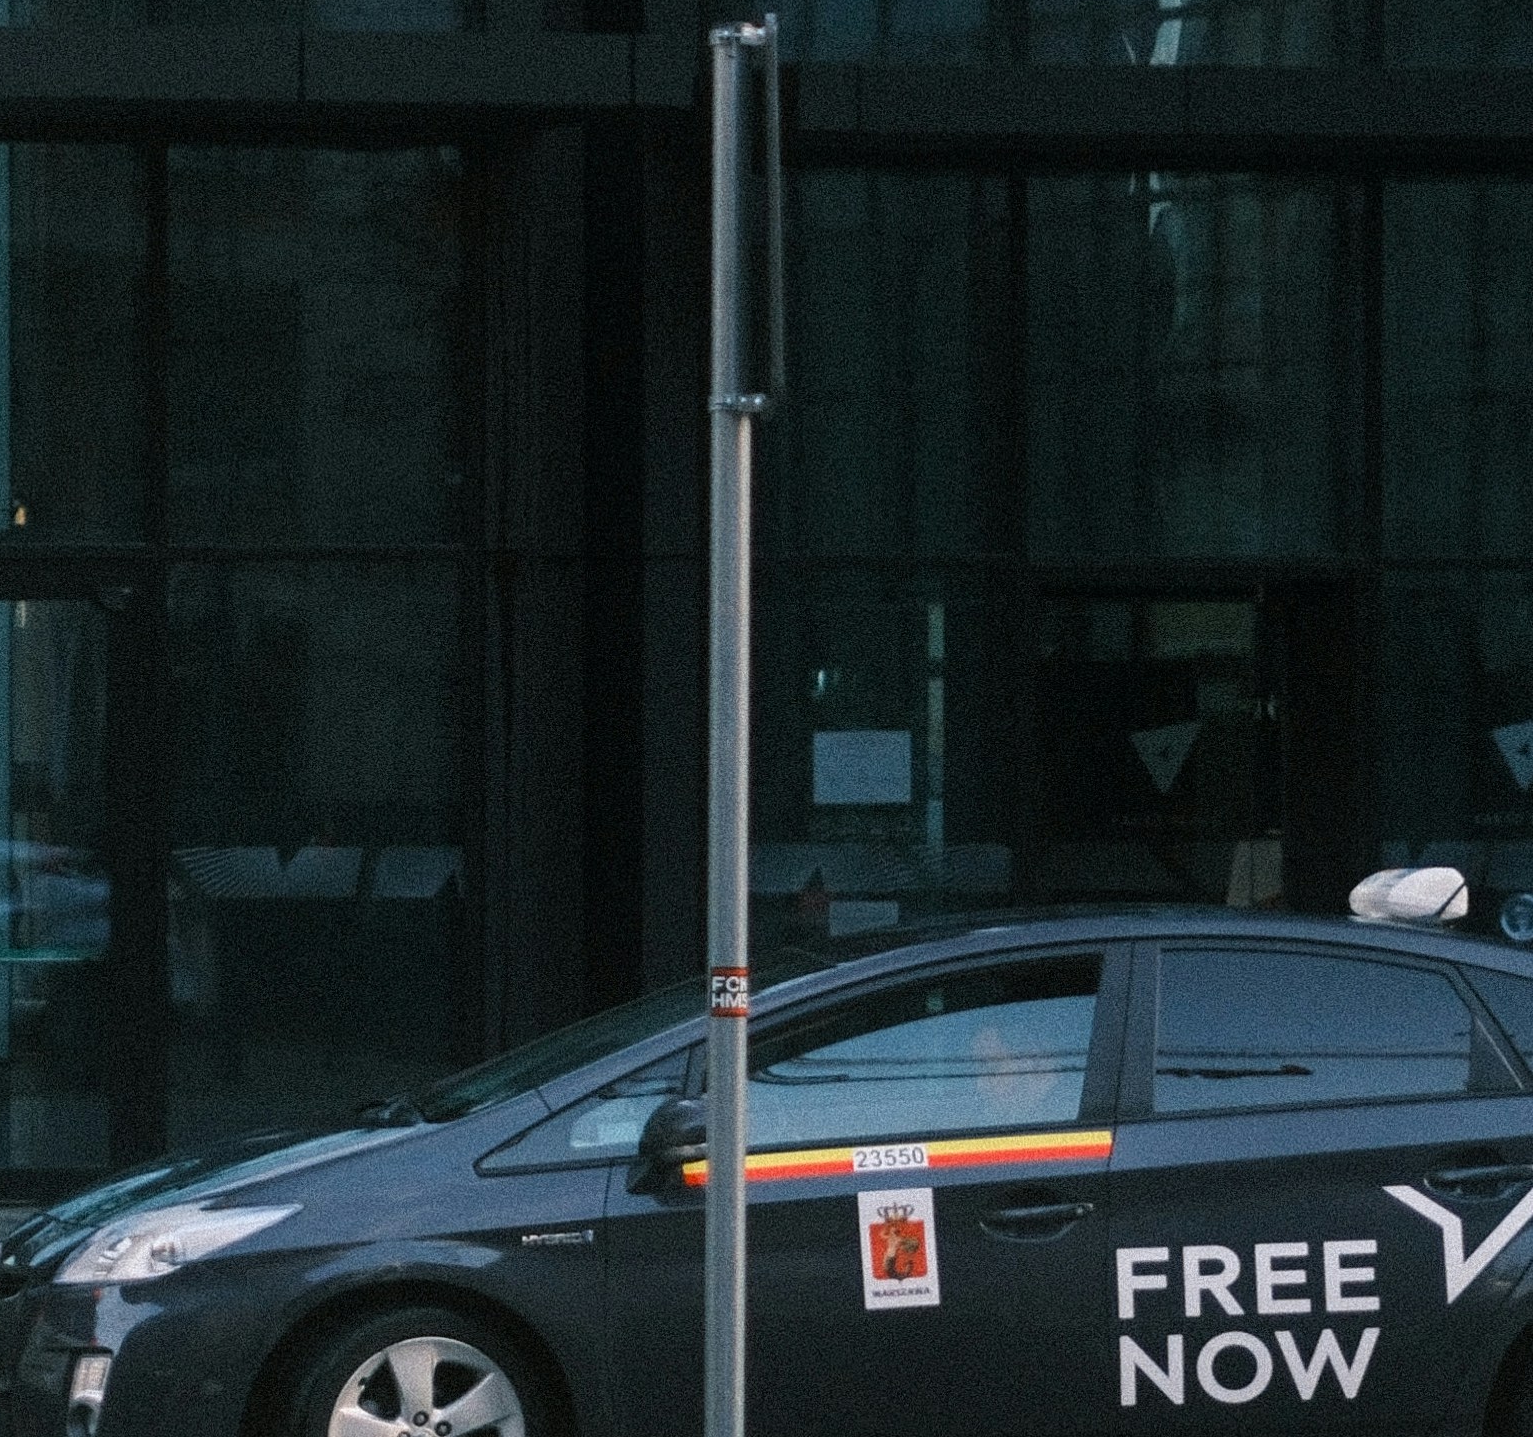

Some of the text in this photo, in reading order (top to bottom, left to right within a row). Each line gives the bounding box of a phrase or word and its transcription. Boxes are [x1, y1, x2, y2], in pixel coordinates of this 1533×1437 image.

[854, 1146, 925, 1168] 23550
[1115, 1239, 1381, 1320] FREE
[1119, 1327, 1381, 1407] NOW
